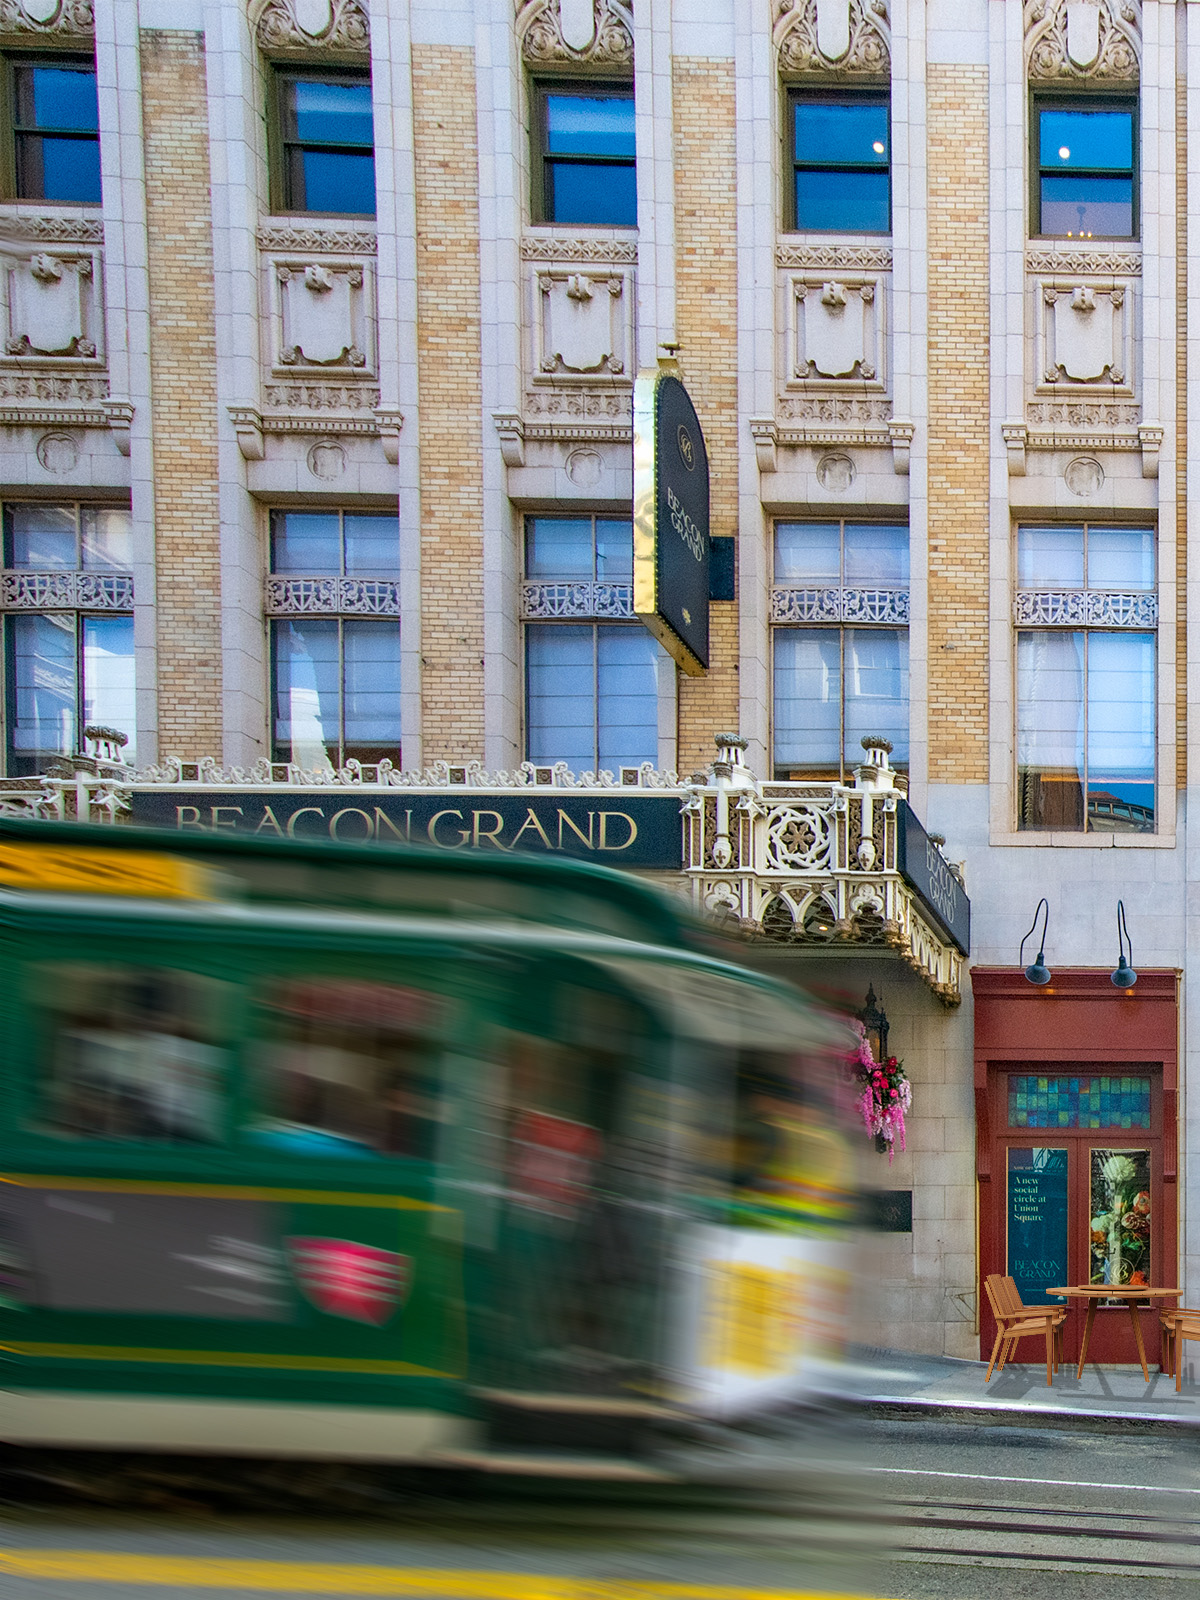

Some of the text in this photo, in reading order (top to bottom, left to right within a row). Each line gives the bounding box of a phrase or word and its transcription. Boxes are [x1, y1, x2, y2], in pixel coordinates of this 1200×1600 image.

[667, 486, 705, 555] BEACON
[671, 512, 702, 562] GRAND
[175, 805, 638, 853] BEACON GRAND
[926, 838, 957, 909] BEACON
[929, 876, 955, 924] GRAND
[1014, 1176, 1021, 1184] A
[1013, 1186, 1038, 1194] social
[1013, 1195, 1037, 1203] circle
[1014, 1204, 1039, 1212] Union
[1013, 1214, 1044, 1223] Square
[1014, 1260, 1060, 1270] BEACON
[1019, 1269, 1056, 1278] GRAND
